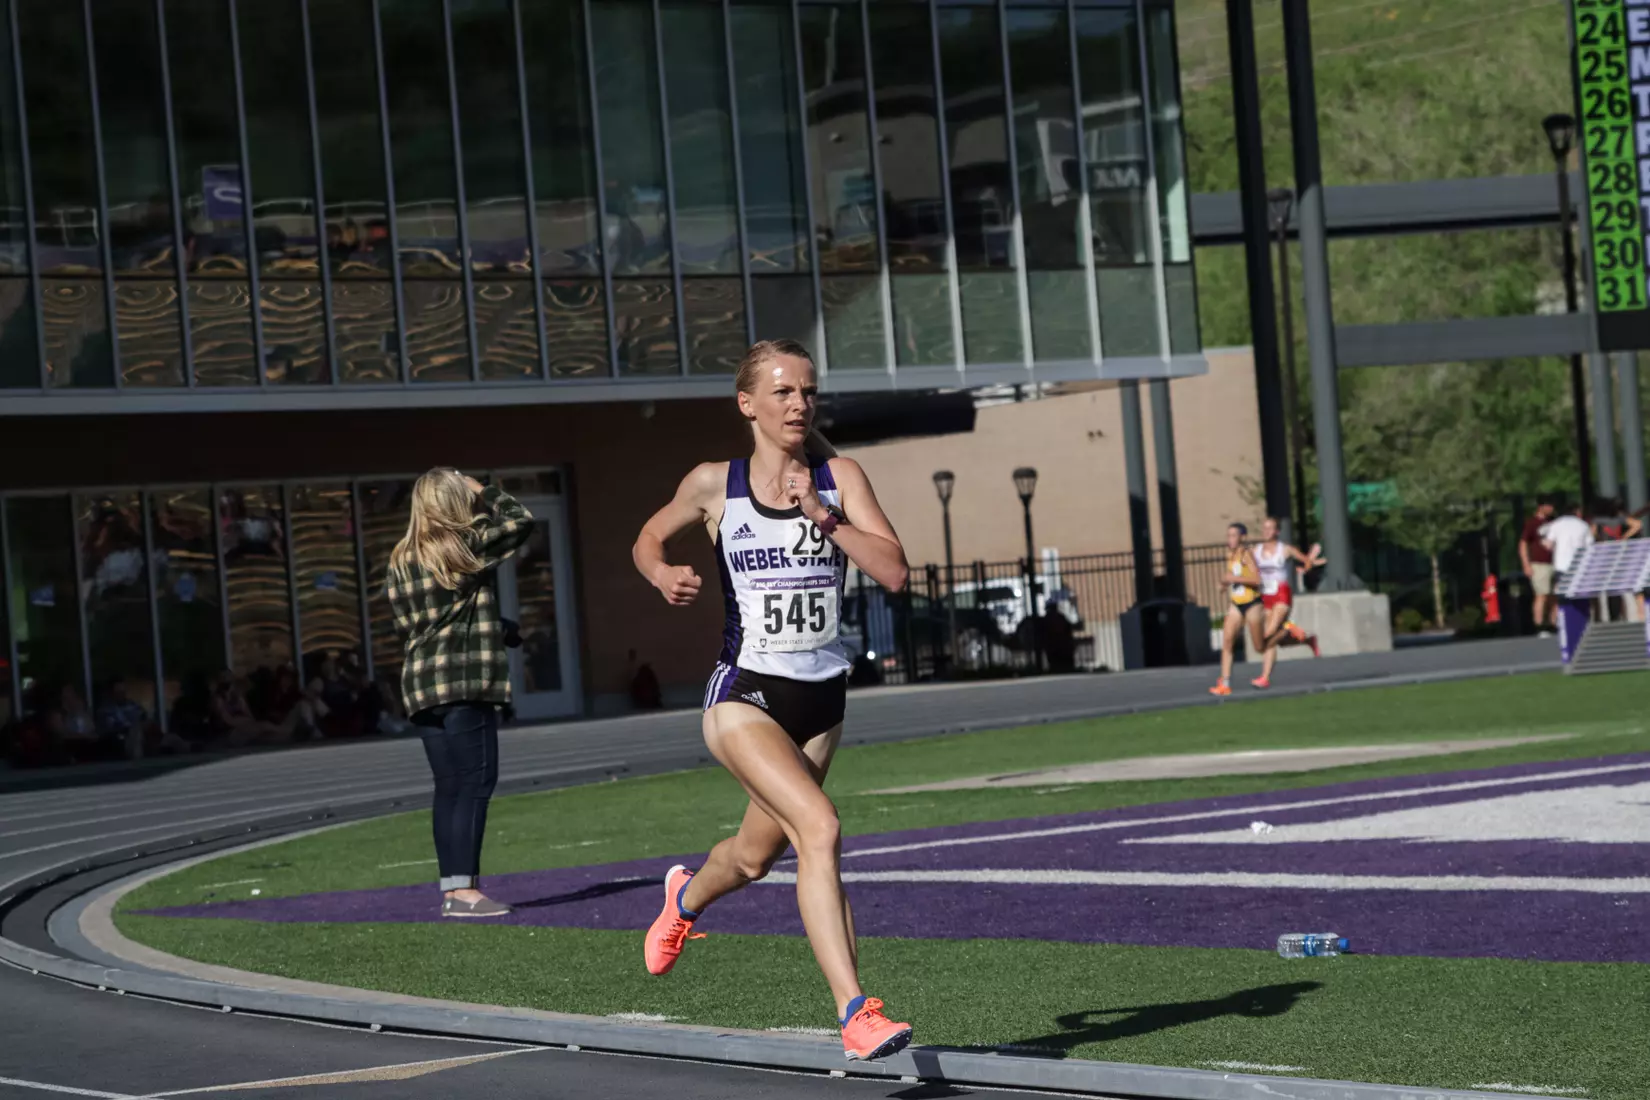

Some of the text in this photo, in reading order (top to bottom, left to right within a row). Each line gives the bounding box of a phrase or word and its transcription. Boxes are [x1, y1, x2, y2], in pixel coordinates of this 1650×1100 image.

[1579, 12, 1622, 45] 24
[1582, 51, 1625, 83] 25
[1585, 88, 1628, 120] 26
[1588, 125, 1629, 157] 27
[1592, 162, 1634, 195] 28
[1595, 200, 1637, 233] 29
[1597, 237, 1640, 271] 30
[1601, 275, 1642, 308] 31
[731, 532, 756, 541] adidas
[792, 522, 826, 556] 29
[729, 547, 792, 573] WEBER
[763, 592, 826, 635] 545
